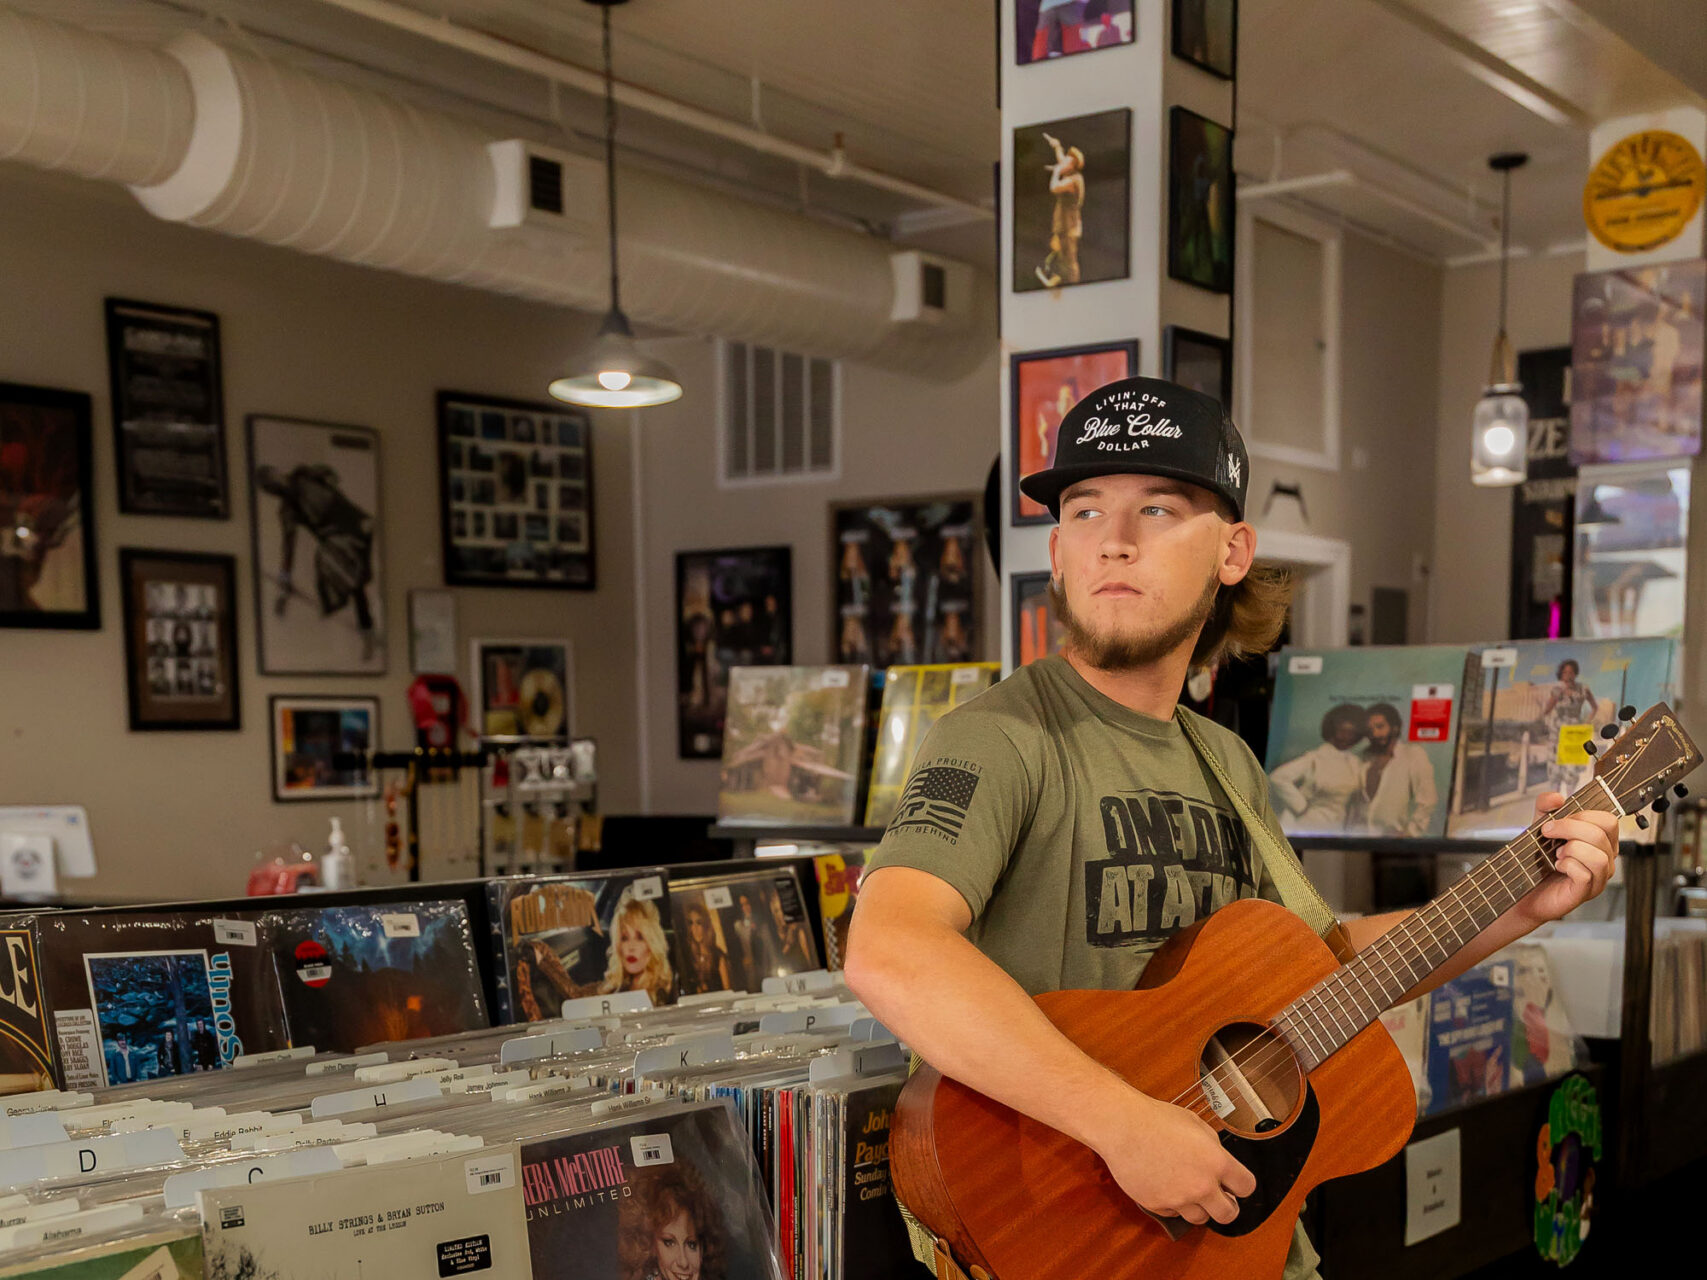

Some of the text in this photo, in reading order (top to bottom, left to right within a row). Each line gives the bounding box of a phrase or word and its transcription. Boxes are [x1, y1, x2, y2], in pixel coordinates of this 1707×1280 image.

[1096, 391, 1167, 411] LIVIN' OFF
[1113, 402, 1145, 412] THAT
[1076, 413, 1183, 445] Blue Collar
[1097, 440, 1150, 452] DOLLAR
[937, 757, 983, 774] PROJECT
[915, 825, 957, 845] BEHIND
[1100, 796, 1184, 857] ONE
[1097, 864, 1155, 935] AT
[1161, 865, 1195, 929] A
[602, 1001, 612, 1015] R
[806, 1016, 816, 1030] P
[680, 1051, 689, 1067] K
[863, 1109, 890, 1134] Joh
[78, 1149, 97, 1173] D
[855, 1141, 890, 1165] Payc
[554, 1145, 628, 1197] McENTIRE
[855, 1168, 888, 1186] Sunday
[308, 1201, 445, 1236] BILLY STRINGS & BRYAN SUTTON
